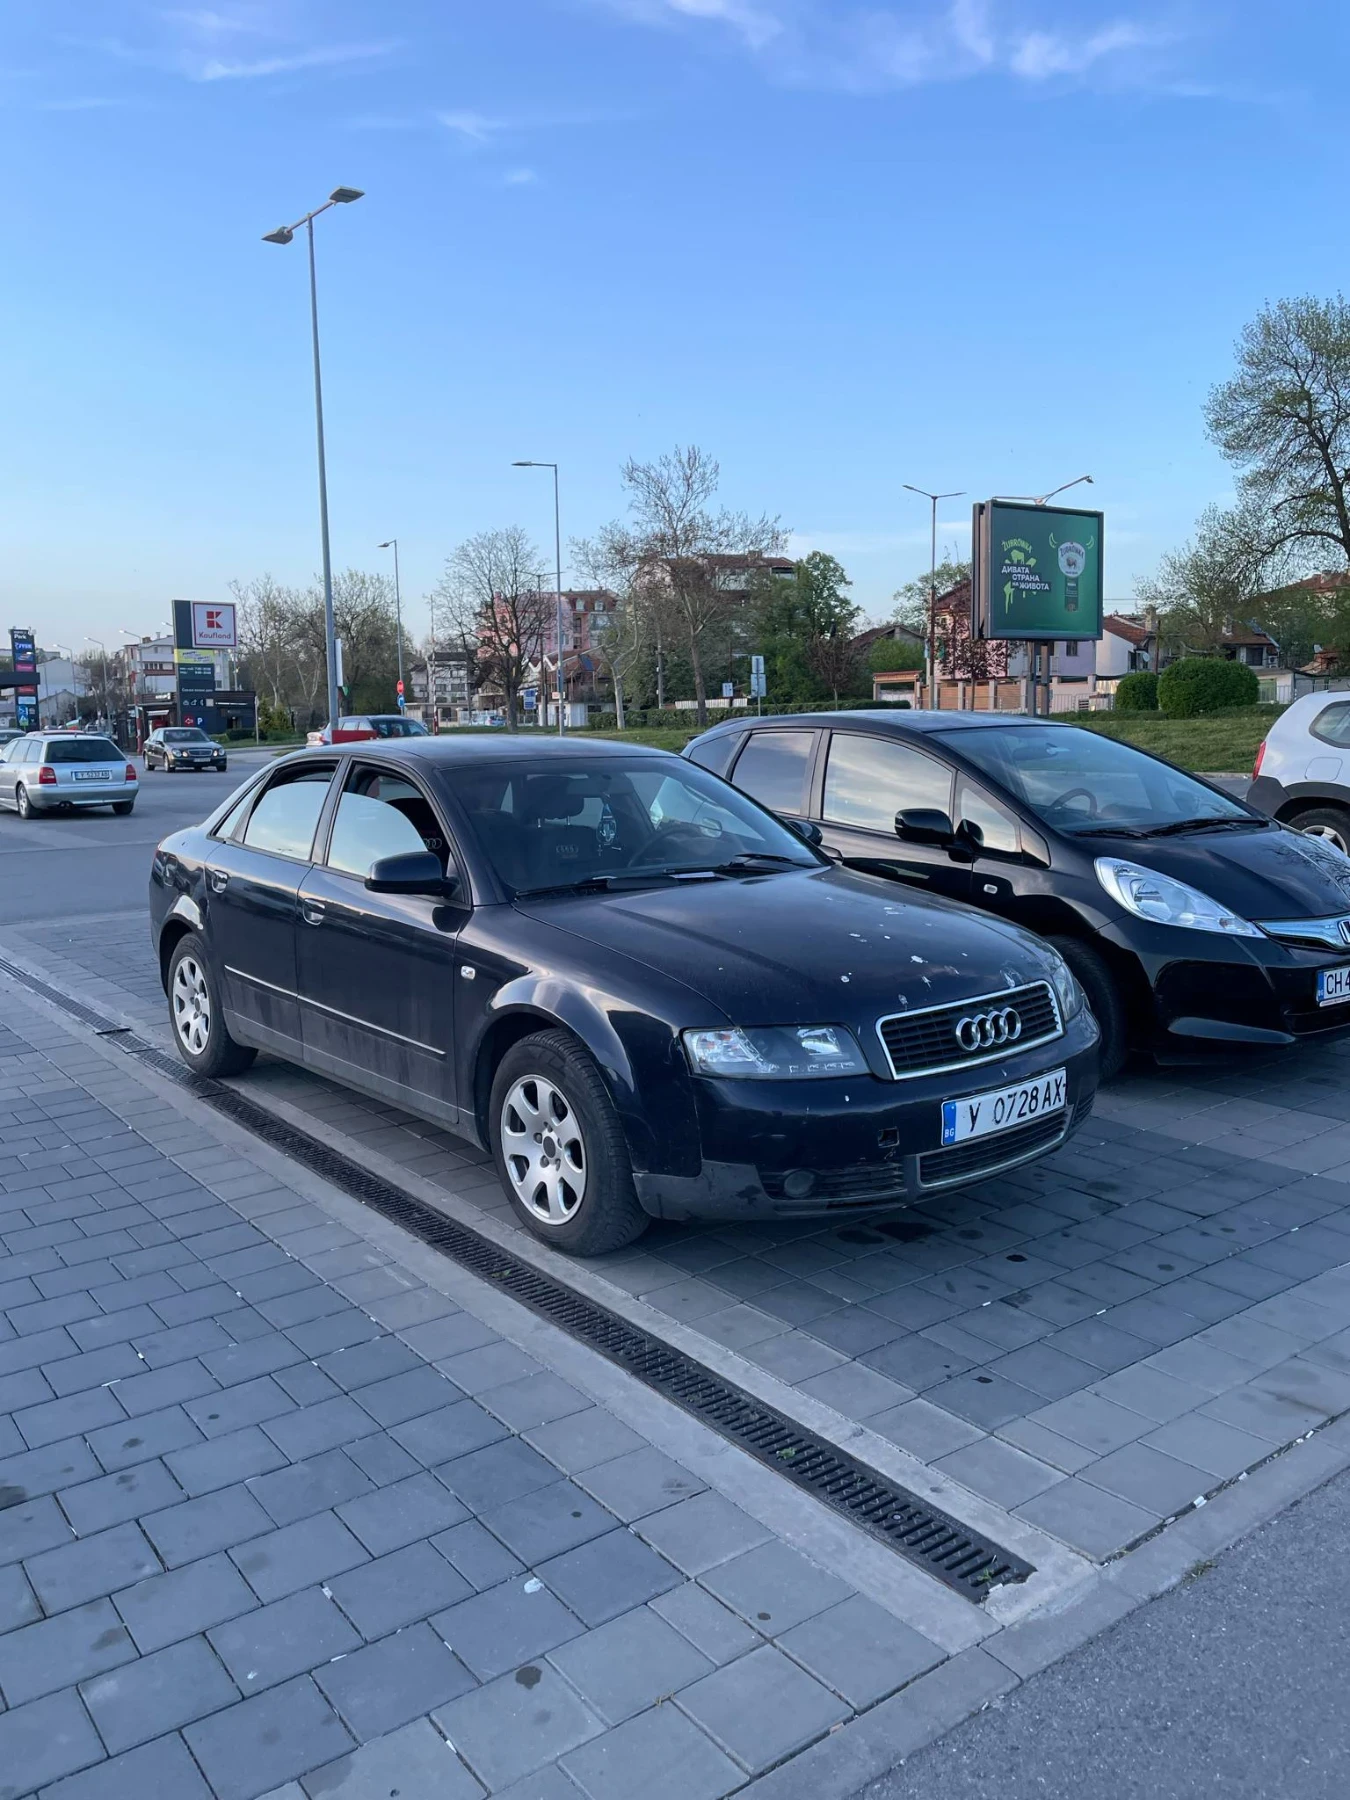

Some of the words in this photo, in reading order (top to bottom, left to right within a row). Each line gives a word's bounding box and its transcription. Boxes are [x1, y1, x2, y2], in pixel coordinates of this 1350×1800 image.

[1001, 565, 1030, 574] ДИВАТА
[1012, 573, 1040, 582] СТРАНА
[1020, 582, 1050, 590] ЖИВОТА
[199, 631, 232, 639] Kaufland
[197, 717, 203, 725] P
[944, 1127, 955, 1138] BG
